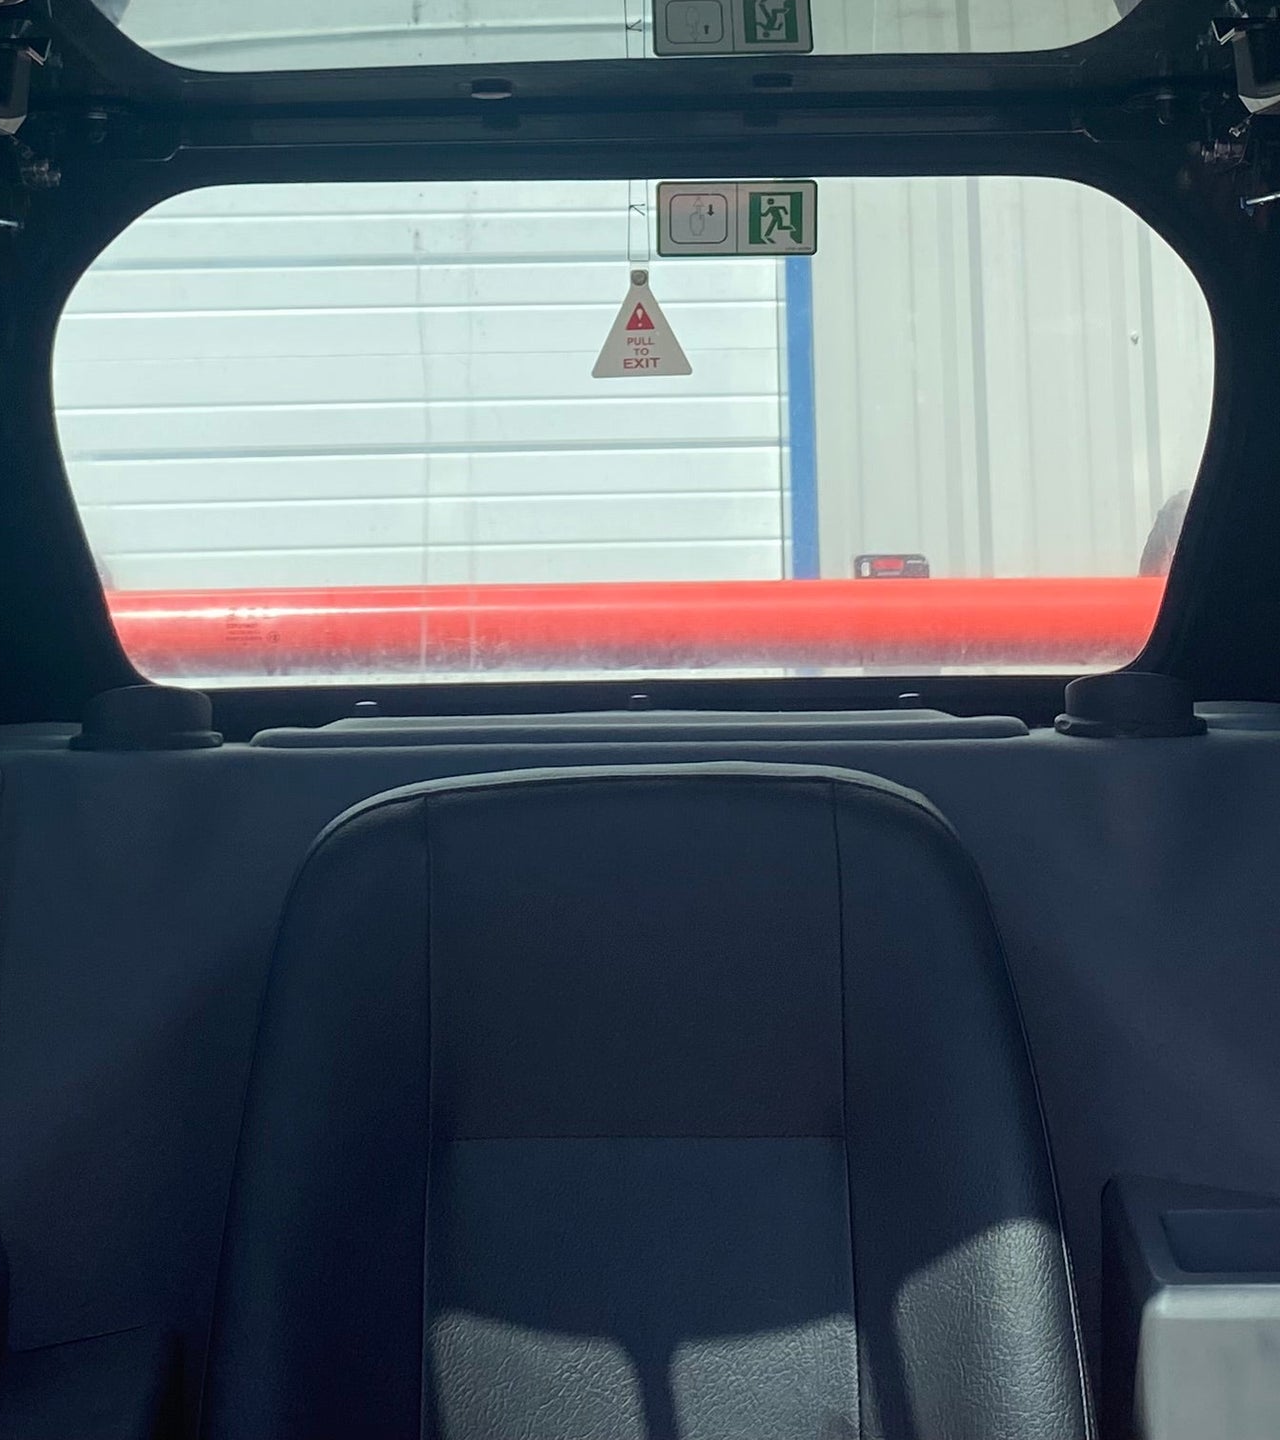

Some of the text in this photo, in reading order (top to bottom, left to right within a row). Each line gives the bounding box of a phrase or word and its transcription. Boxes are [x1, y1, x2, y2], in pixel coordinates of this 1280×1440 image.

[627, 336, 656, 346] PULL
[633, 347, 649, 356] TO
[623, 357, 661, 369] EXIT
